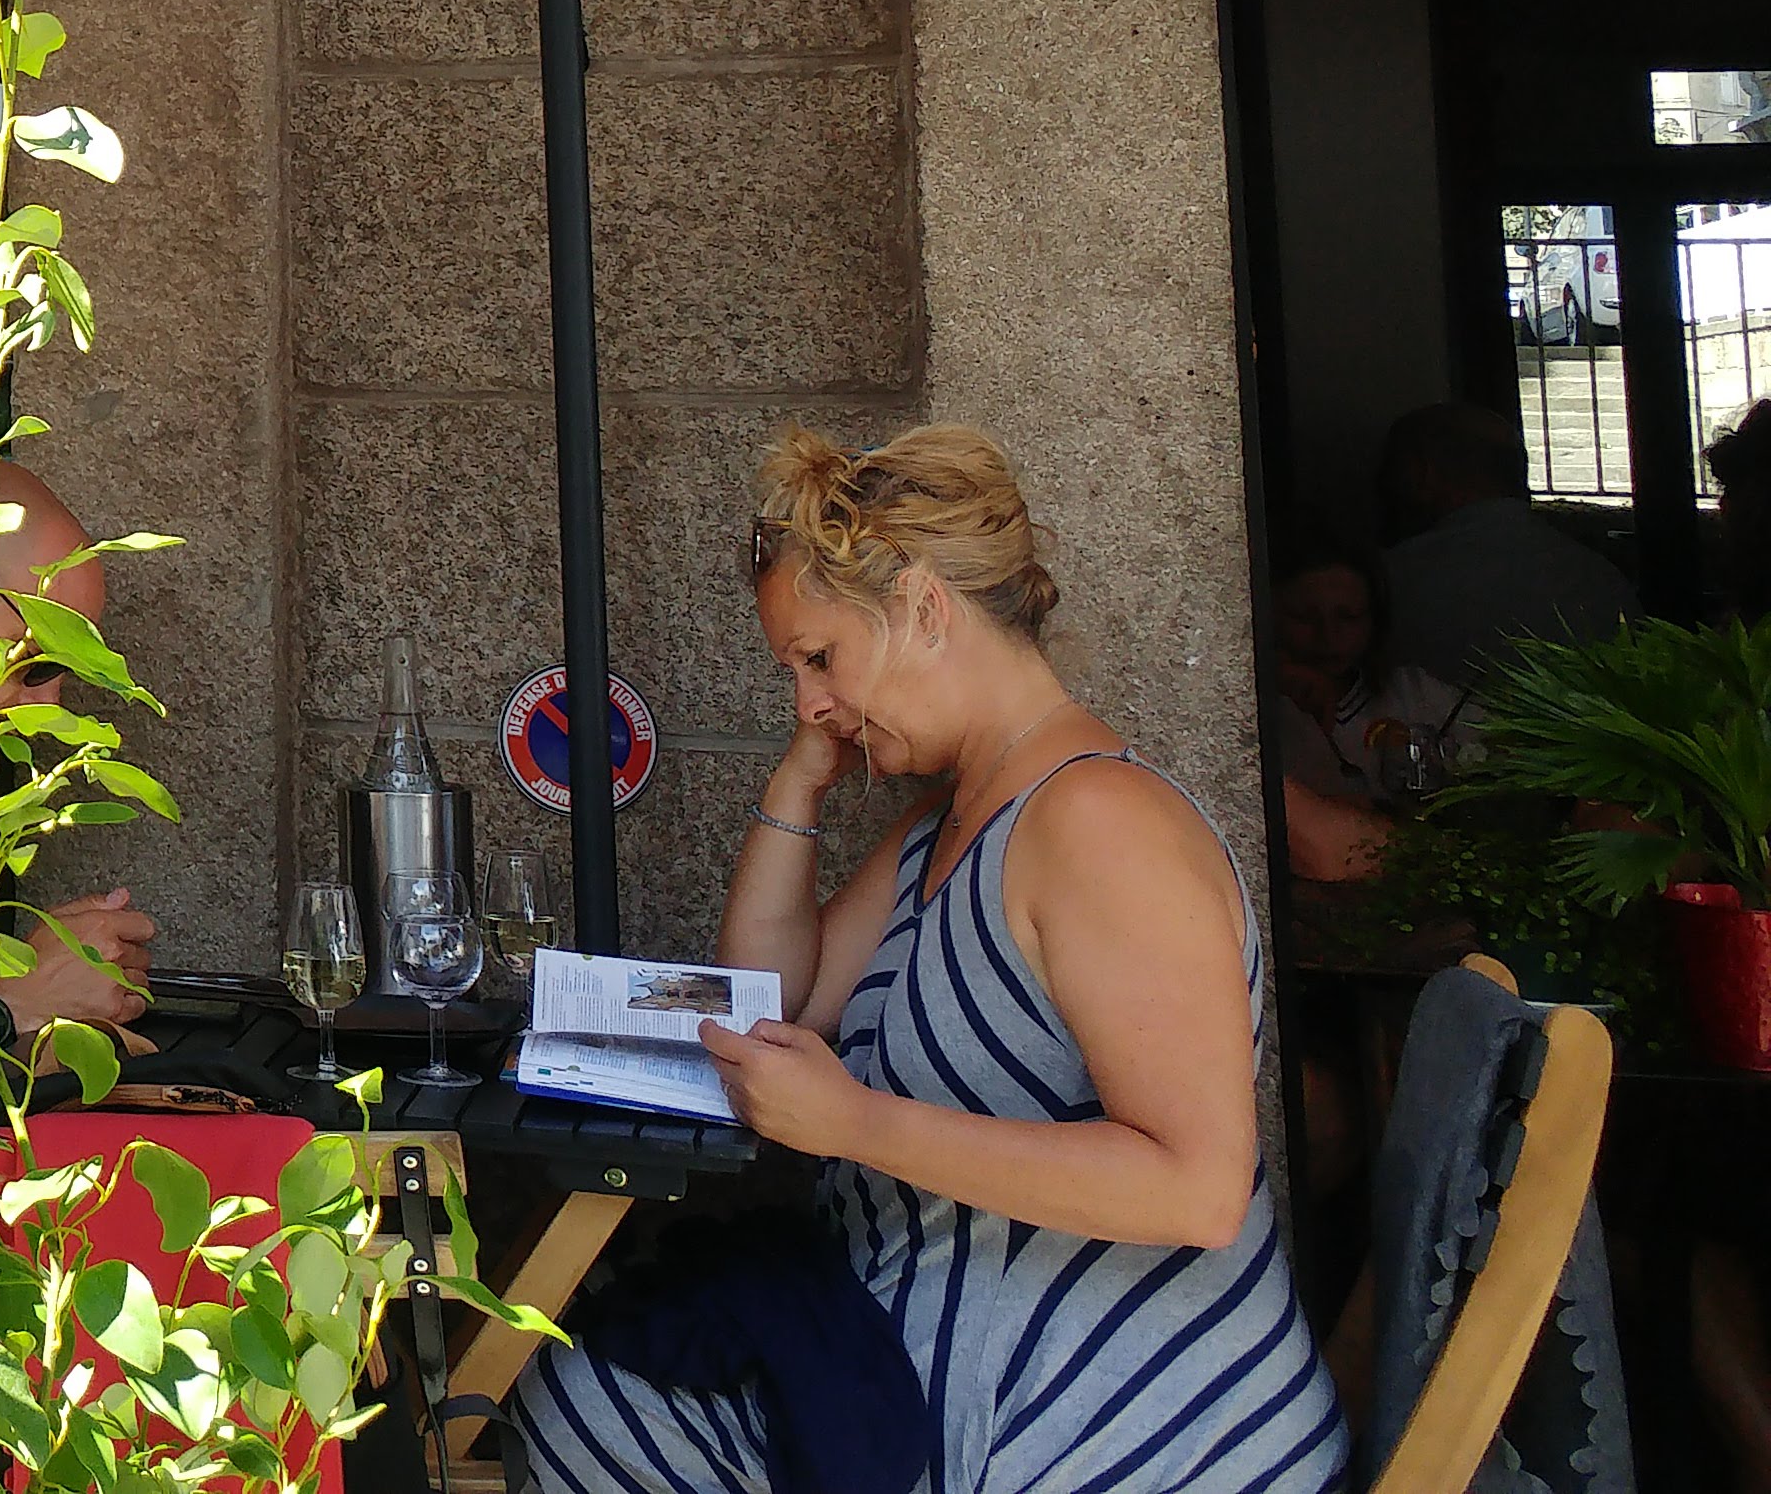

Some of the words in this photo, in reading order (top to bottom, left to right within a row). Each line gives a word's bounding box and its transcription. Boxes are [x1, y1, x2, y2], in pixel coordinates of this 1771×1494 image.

[507, 678, 553, 736] DEFENSE
[609, 681, 651, 741] TIONNER
[530, 777, 570, 805] JOUR
